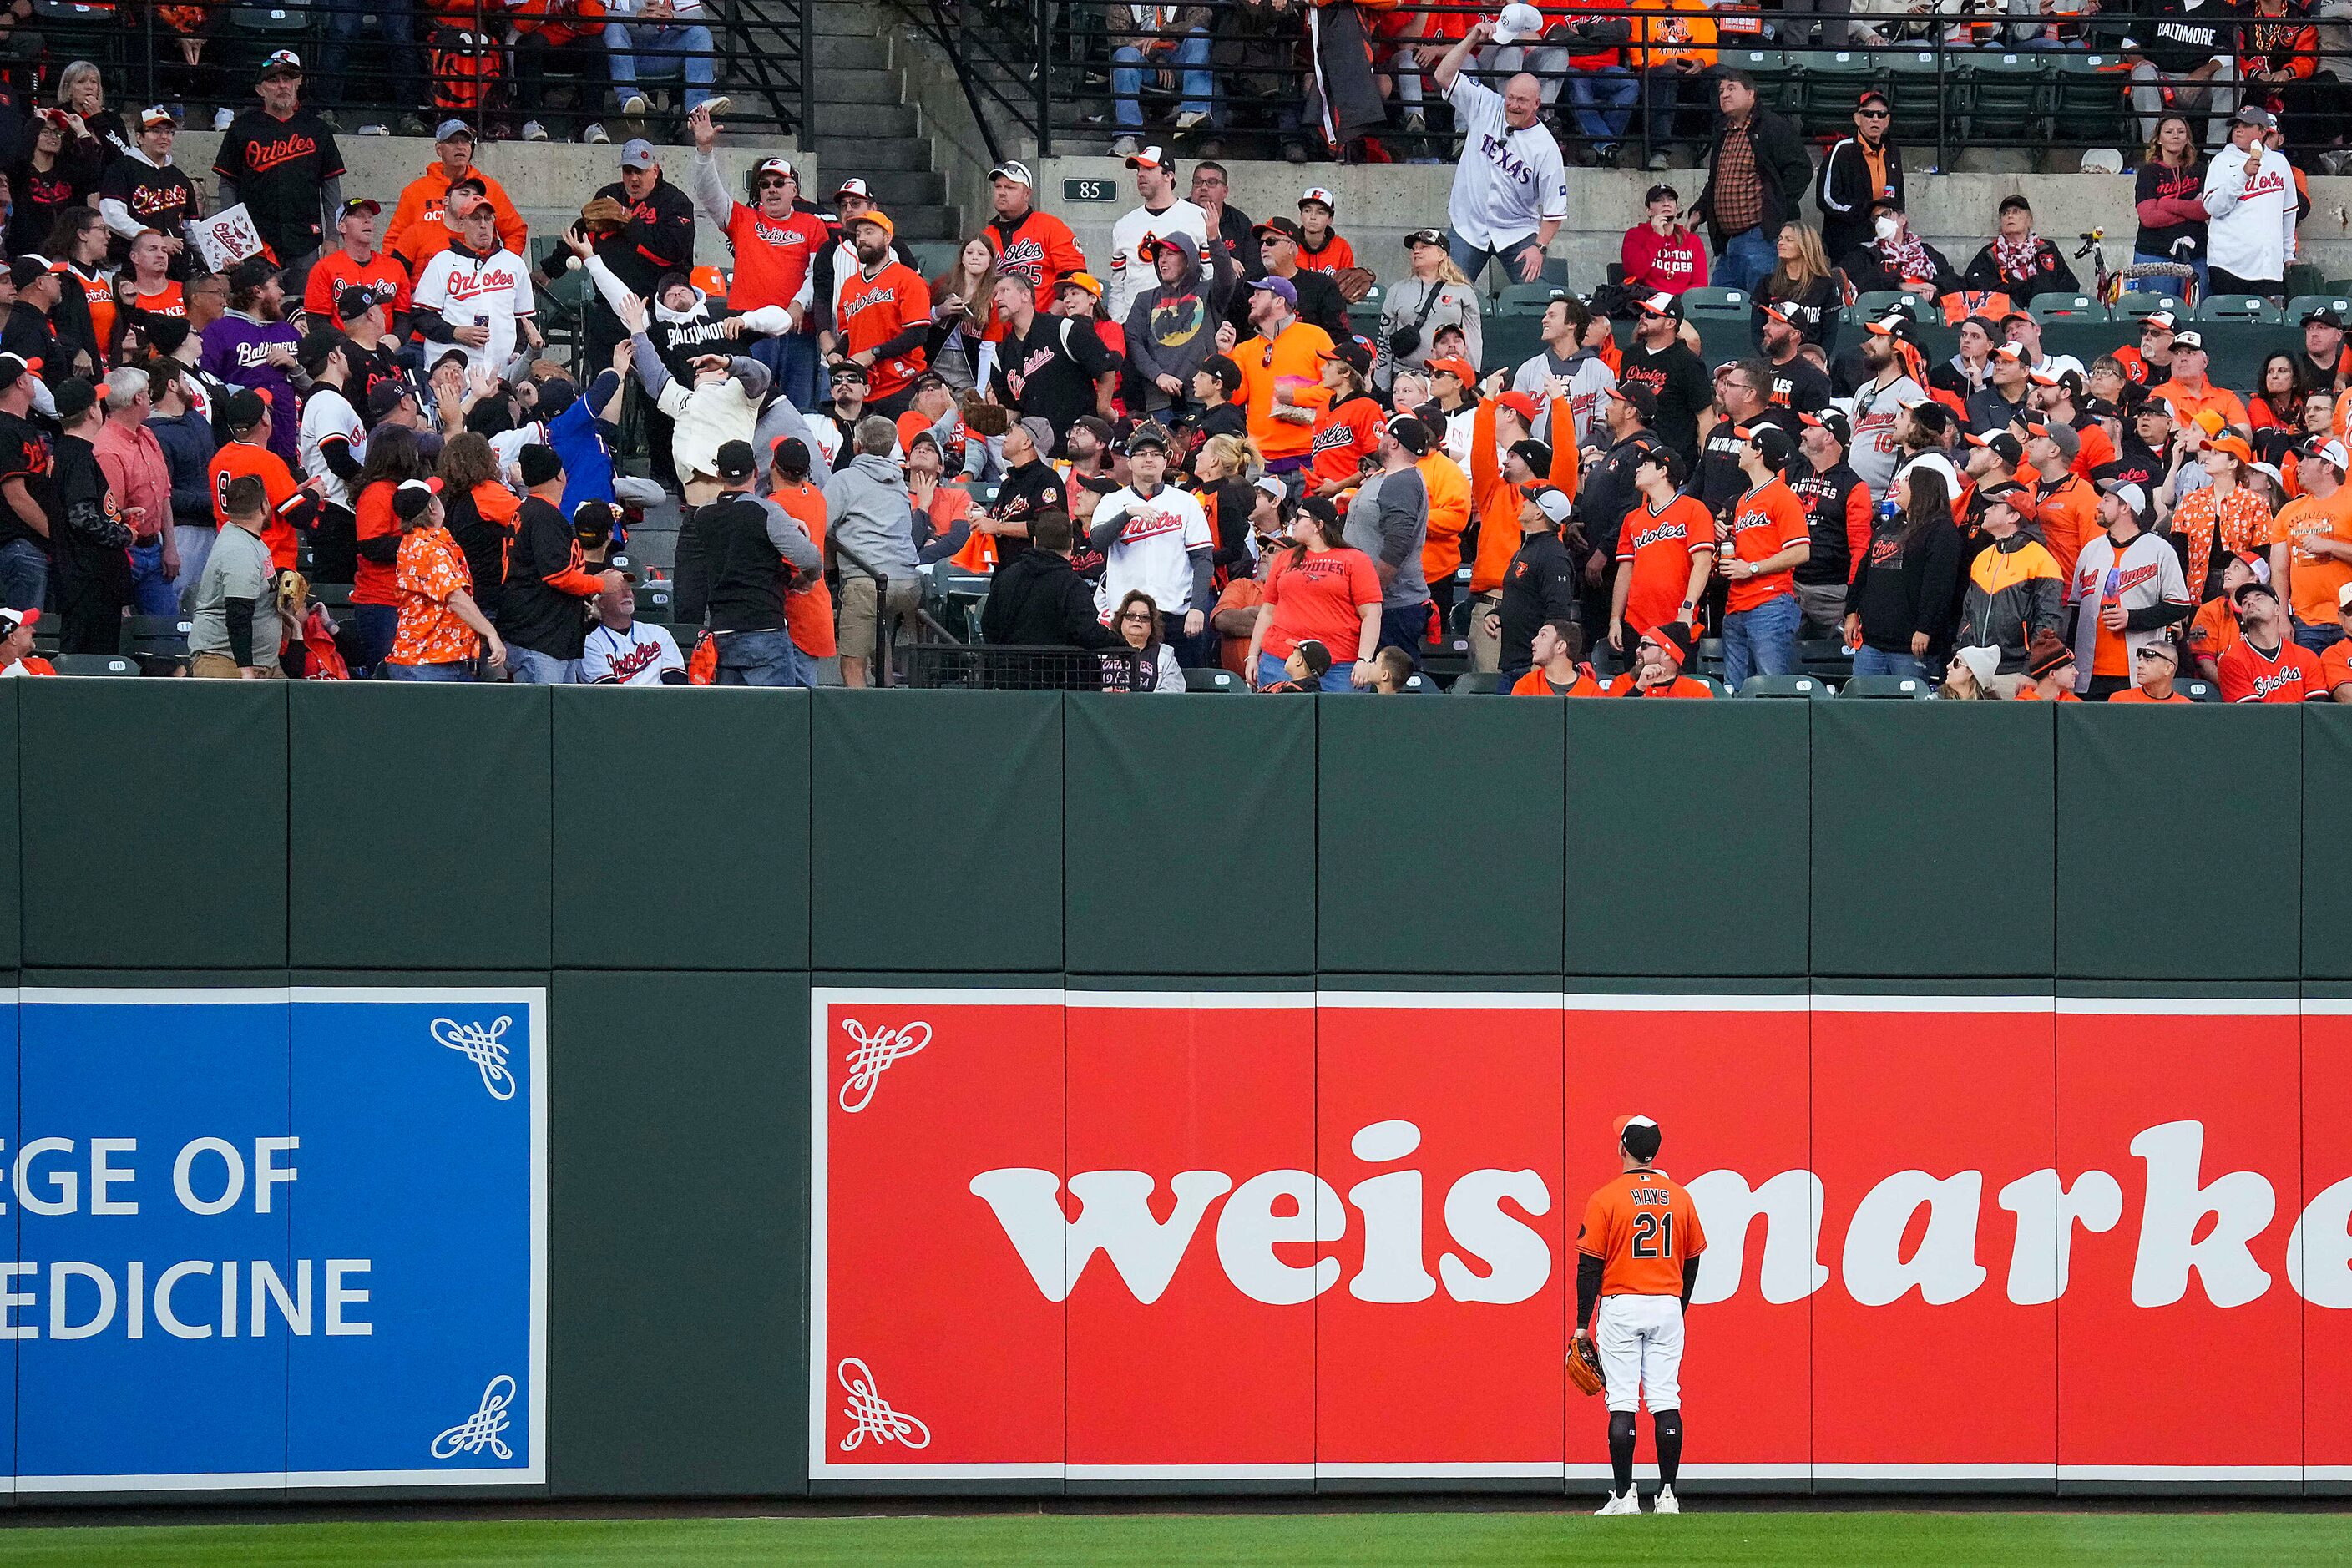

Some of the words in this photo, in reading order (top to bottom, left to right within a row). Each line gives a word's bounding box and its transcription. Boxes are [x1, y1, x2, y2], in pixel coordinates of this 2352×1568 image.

[2157, 23, 2216, 47] BALTIMORE
[245, 134, 317, 172] Orioles
[1480, 134, 1533, 185] TEXAS
[1080, 181, 1100, 198] 85
[212, 222, 245, 259] Orioles
[447, 269, 515, 297] Orioles
[667, 321, 726, 345] BALTIMOR
[1626, 365, 1669, 385] Orioles
[2087, 398, 2097, 409] B
[1874, 433, 1894, 454] 10
[1790, 482, 1838, 500] ORIOLES
[615, 557, 625, 566] 16
[655, 594, 665, 603] 16
[605, 640, 661, 675] Orioles
[2253, 665, 2302, 698] Orioles
[0, 1136, 139, 1216] GE
[173, 1136, 300, 1216] OF
[1631, 1189, 1670, 1206] HAYS
[969, 1120, 1551, 1305] weis
[1631, 1211, 1672, 1259] 21
